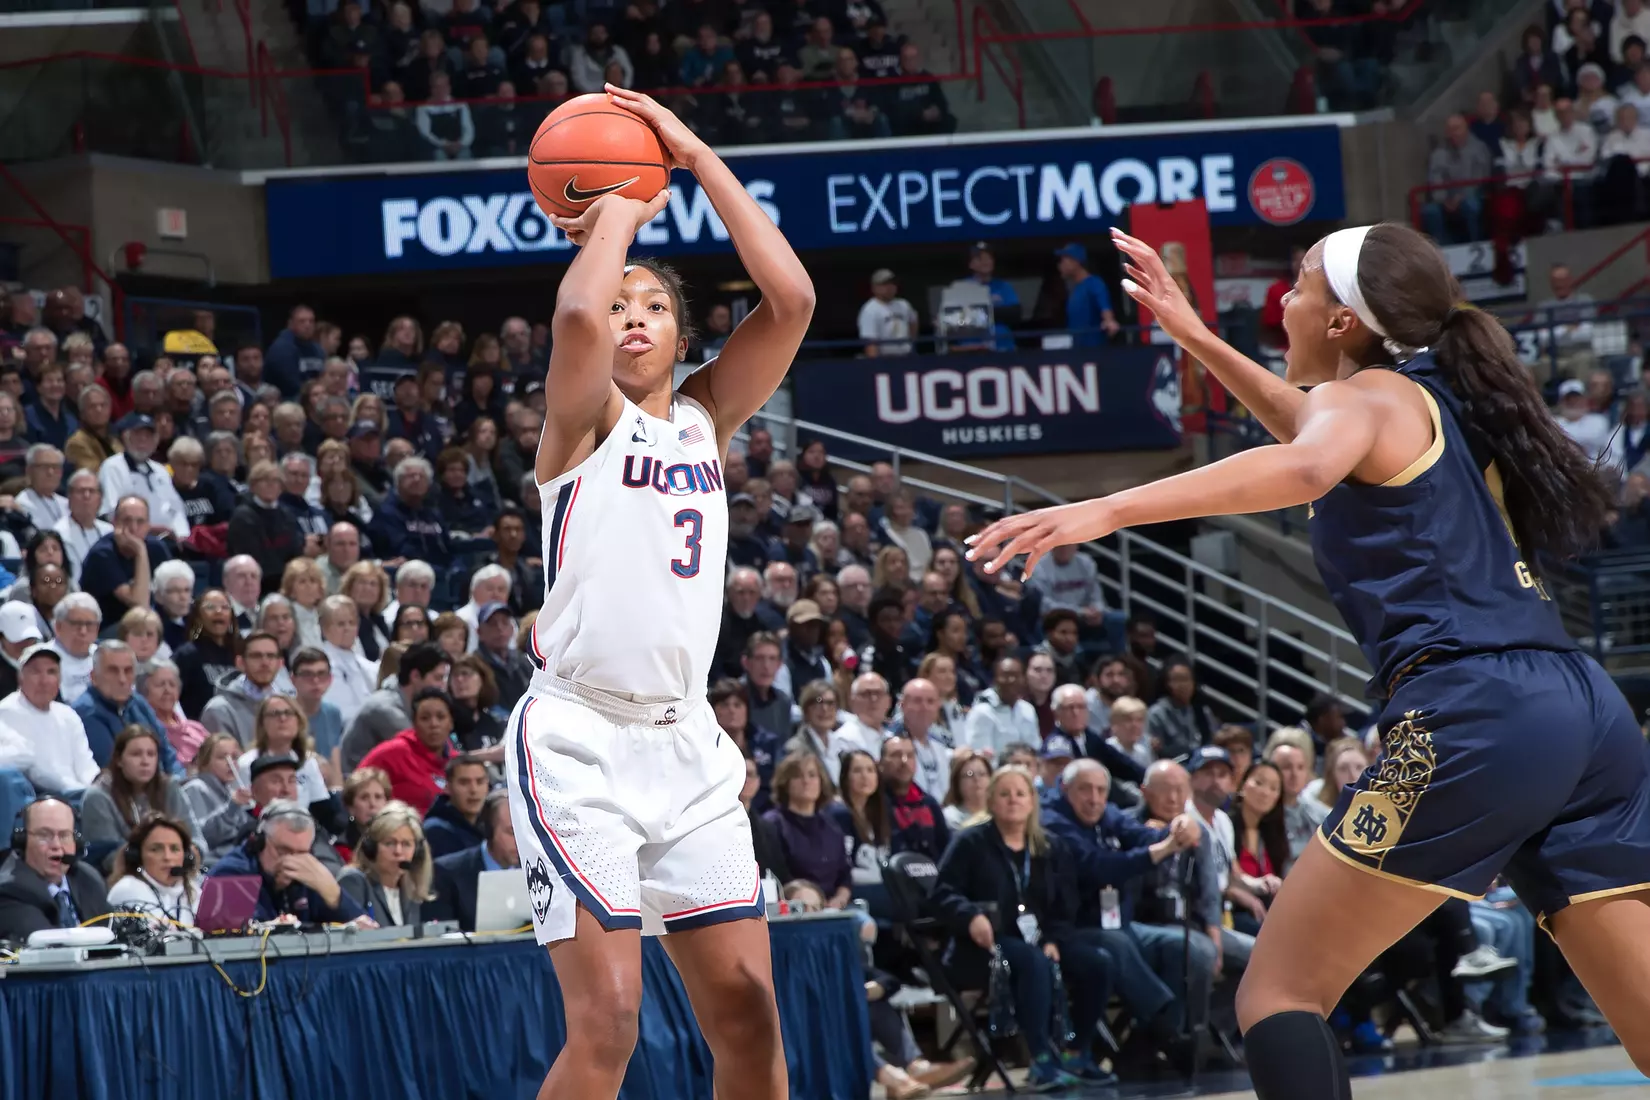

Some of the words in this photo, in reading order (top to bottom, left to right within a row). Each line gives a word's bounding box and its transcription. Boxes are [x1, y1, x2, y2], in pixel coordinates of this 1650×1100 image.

[875, 363, 1100, 424] UCONN
[942, 423, 1043, 444] HUSKIES
[670, 508, 704, 579] 3
[654, 718, 678, 726] UCONN
